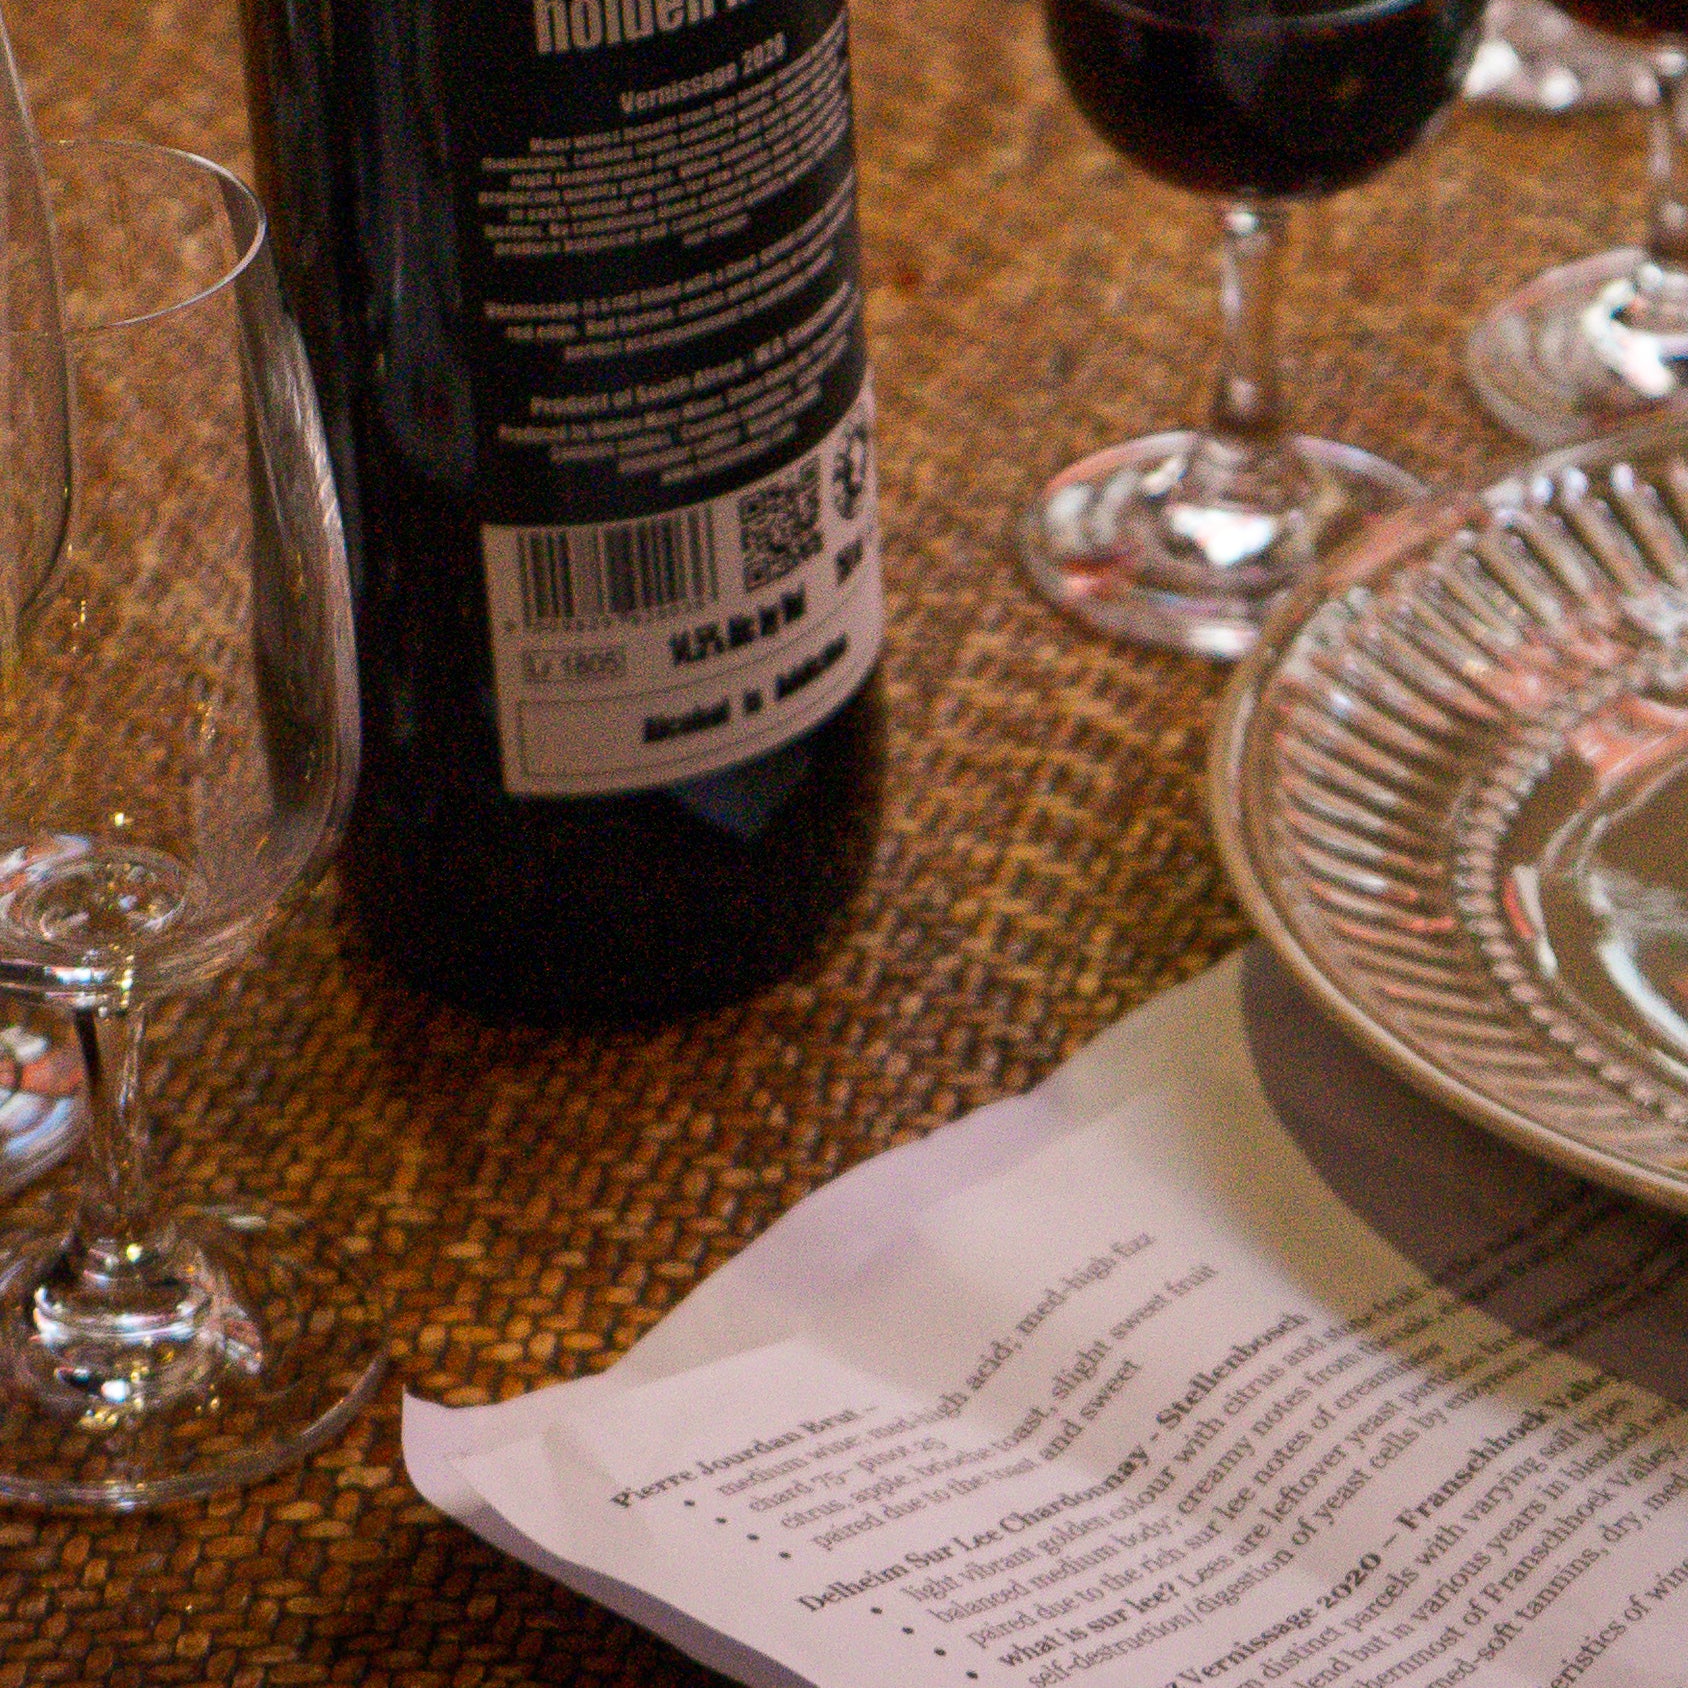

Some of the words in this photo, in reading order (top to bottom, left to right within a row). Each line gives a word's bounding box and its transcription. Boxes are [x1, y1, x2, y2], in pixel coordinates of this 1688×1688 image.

[619, 62, 738, 113] Vernissage
[610, 1469, 699, 1509] Pierre
[694, 1429, 804, 1477] Jourdan
[798, 1409, 862, 1435] Brut
[715, 1457, 811, 1498] medium
[1014, 1255, 1120, 1337] med-high
[1109, 1231, 1158, 1260] fizz
[748, 1477, 814, 1512] chard
[856, 1444, 912, 1476] pinot
[795, 1563, 911, 1613] Delheim
[902, 1544, 956, 1567] Sur
[951, 1527, 1005, 1554] Lee
[997, 1442, 1152, 1535] Chardonnay
[1154, 1311, 1312, 1431] Stellenbosch
[810, 1509, 886, 1553] paired
[881, 1496, 928, 1521] due
[921, 1485, 952, 1504] to
[946, 1473, 988, 1496] the
[1039, 1416, 1087, 1463] and
[1078, 1357, 1143, 1423] sweet
[899, 1574, 962, 1603] light
[957, 1546, 1040, 1583] vibrant
[1035, 1514, 1112, 1558] golden
[1107, 1464, 1178, 1522] colour
[1172, 1414, 1228, 1466] with
[1220, 1362, 1288, 1418] citrus
[1280, 1336, 1330, 1368] and
[906, 1447, 994, 1479] brioche
[990, 1405, 1060, 1453] toast,
[1051, 1338, 1114, 1402] slight
[1109, 1292, 1173, 1342] sweet
[1164, 1263, 1220, 1298] fruit
[925, 1578, 1034, 1625] balanced
[1028, 1542, 1122, 1591] medium
[1174, 1436, 1258, 1518] creamy
[1249, 1384, 1314, 1439] notes
[1300, 1351, 1363, 1392] from
[966, 1611, 1040, 1651] paired
[1034, 1596, 1082, 1622] due
[1073, 1584, 1106, 1605] to
[1099, 1564, 1145, 1594] the
[1139, 1546, 1188, 1574] rich
[1182, 1517, 1226, 1552] sur
[1210, 1484, 1260, 1523] lee
[1250, 1428, 1316, 1489] notes
[1309, 1401, 1340, 1432] of
[996, 1631, 1067, 1669] what
[1055, 1627, 1090, 1645] is
[1085, 1606, 1131, 1635] sur
[1121, 1579, 1182, 1614] lee?
[1176, 1553, 1238, 1590] Lees
[1231, 1520, 1275, 1558] are
[1258, 1441, 1351, 1526] leftover
[1342, 1396, 1406, 1452] yeast
[1028, 1548, 1297, 1688] self-destruction/digestion
[1288, 1514, 1322, 1550] of
[1312, 1466, 1376, 1527] yeast
[1367, 1424, 1423, 1472] cells
[1406, 1406, 1453, 1435] by
[1176, 1606, 1320, 1686] Vernissage
[1314, 1551, 1383, 1612] 2020
[1395, 1408, 1555, 1533] Franschhoek
[1262, 1625, 1348, 1681] distinct
[1341, 1566, 1421, 1634] parcels
[1413, 1520, 1470, 1569] with
[1462, 1453, 1551, 1525] varying
[1540, 1427, 1582, 1461] soil
[1292, 1655, 1354, 1688] lend
[1339, 1633, 1393, 1664] but
[1381, 1620, 1416, 1642] in
[1409, 1547, 1495, 1626] various
[1485, 1496, 1549, 1558] years
[1533, 1475, 1573, 1503] in
[1558, 1418, 1654, 1484] blended
[1461, 1596, 1492, 1628] of
[1479, 1484, 1617, 1607] Franschhoek
[1513, 1546, 1611, 1622] tannins,
[1598, 1511, 1653, 1546] dry,
[1549, 1618, 1630, 1688] eristics
[1622, 1591, 1653, 1625] of
